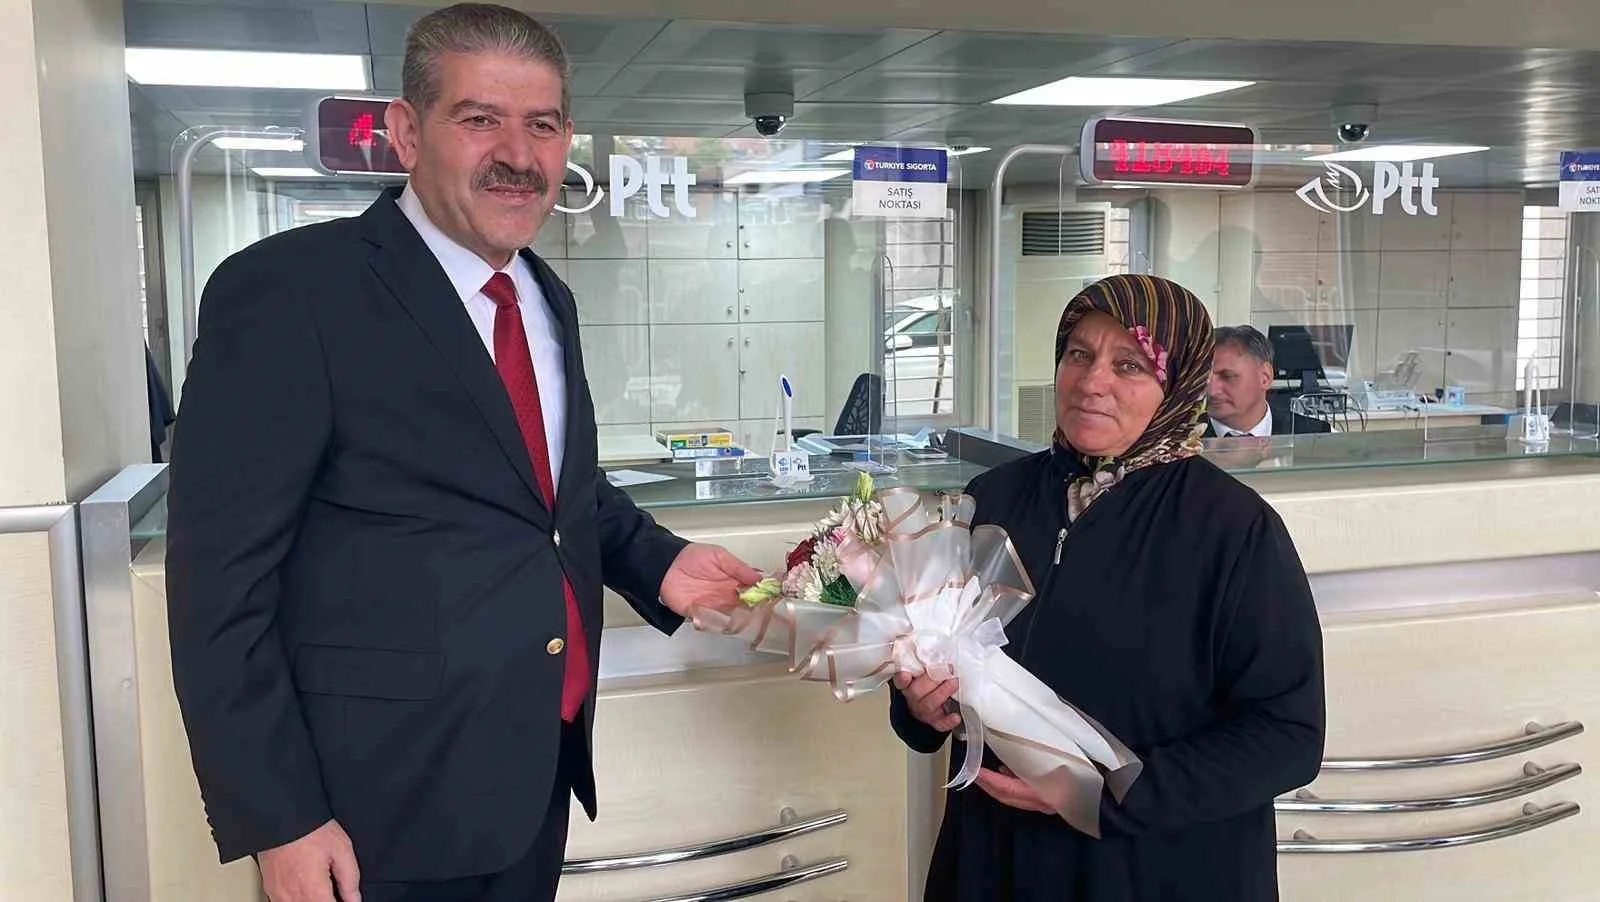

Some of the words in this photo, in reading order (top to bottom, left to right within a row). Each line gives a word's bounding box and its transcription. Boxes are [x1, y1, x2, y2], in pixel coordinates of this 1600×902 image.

[609, 153, 696, 218] Ptt
[879, 199, 921, 209] NOKTASI
[1372, 161, 1440, 216] Ptt
